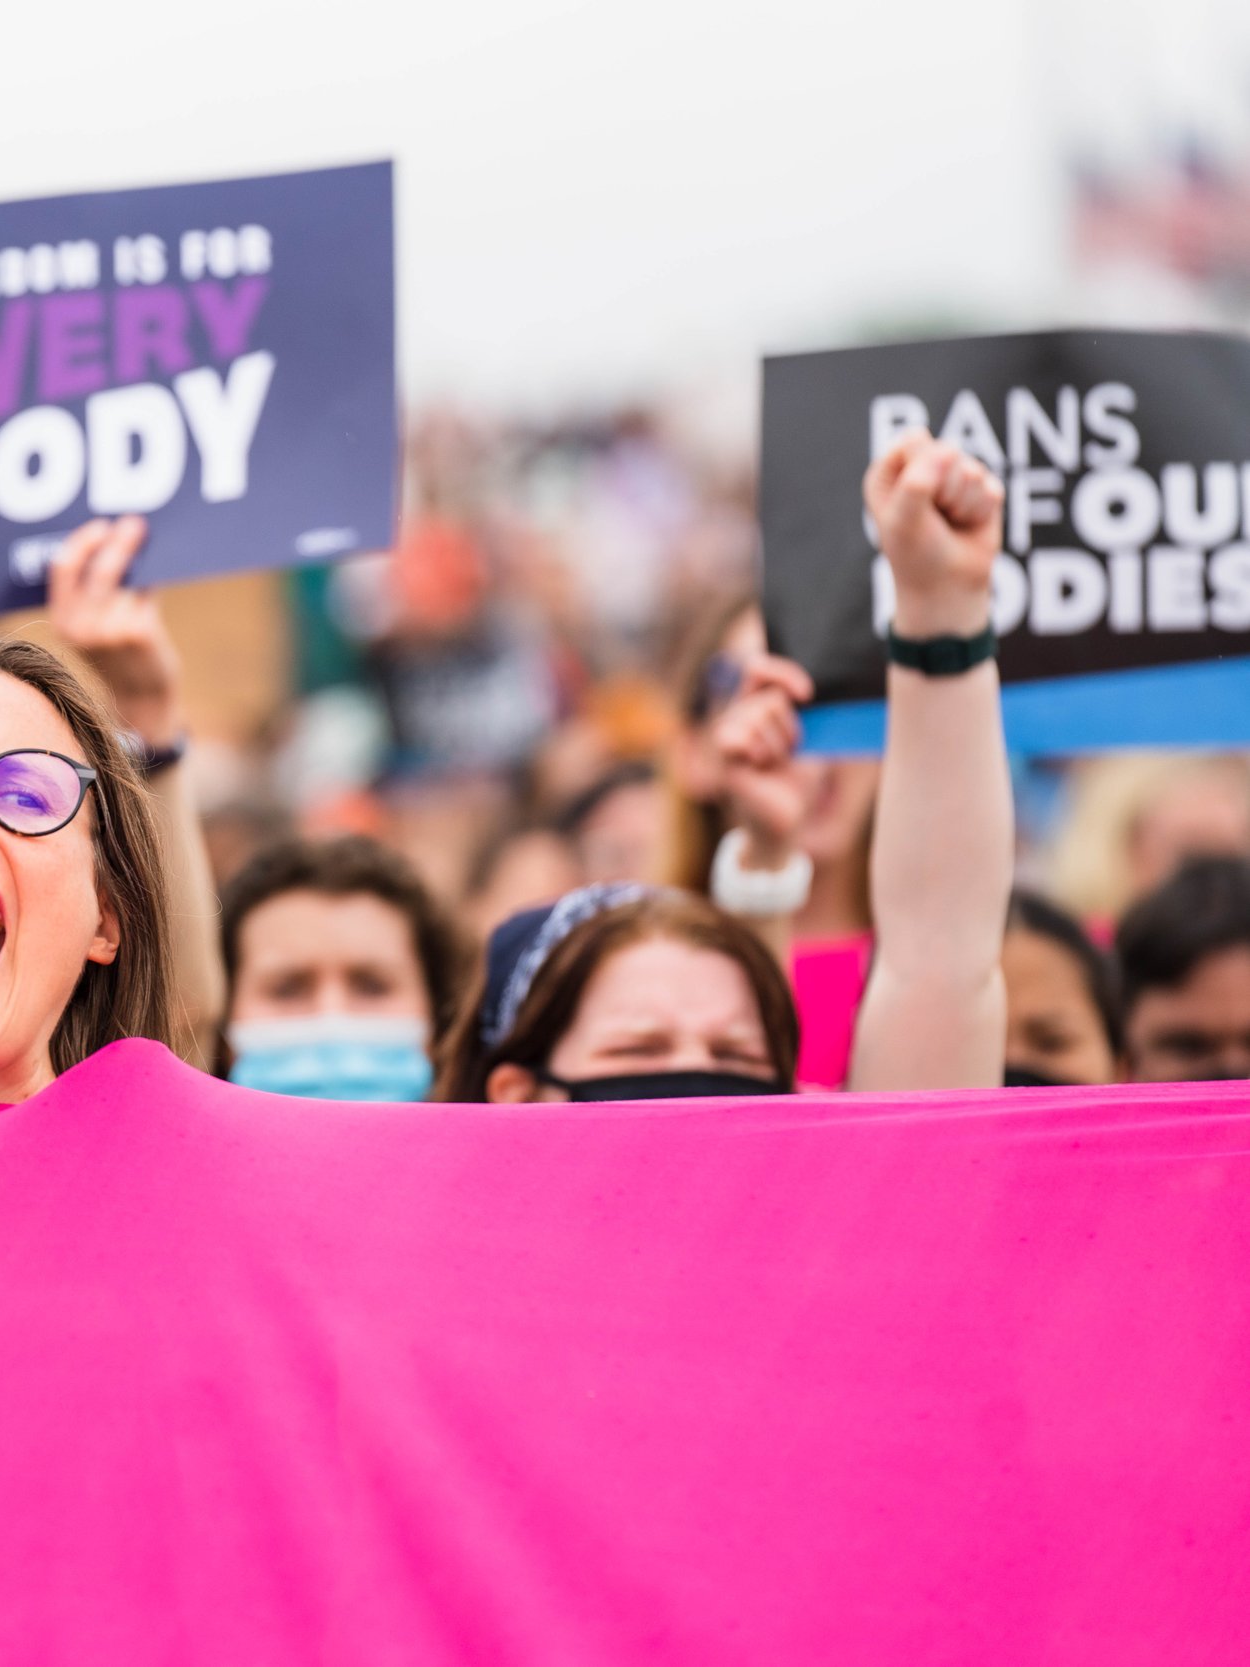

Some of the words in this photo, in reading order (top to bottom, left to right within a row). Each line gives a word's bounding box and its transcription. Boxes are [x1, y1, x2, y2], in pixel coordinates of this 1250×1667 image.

[113, 233, 168, 286] IS
[179, 223, 273, 282] FOR
[1071, 462, 1250, 550] OU
